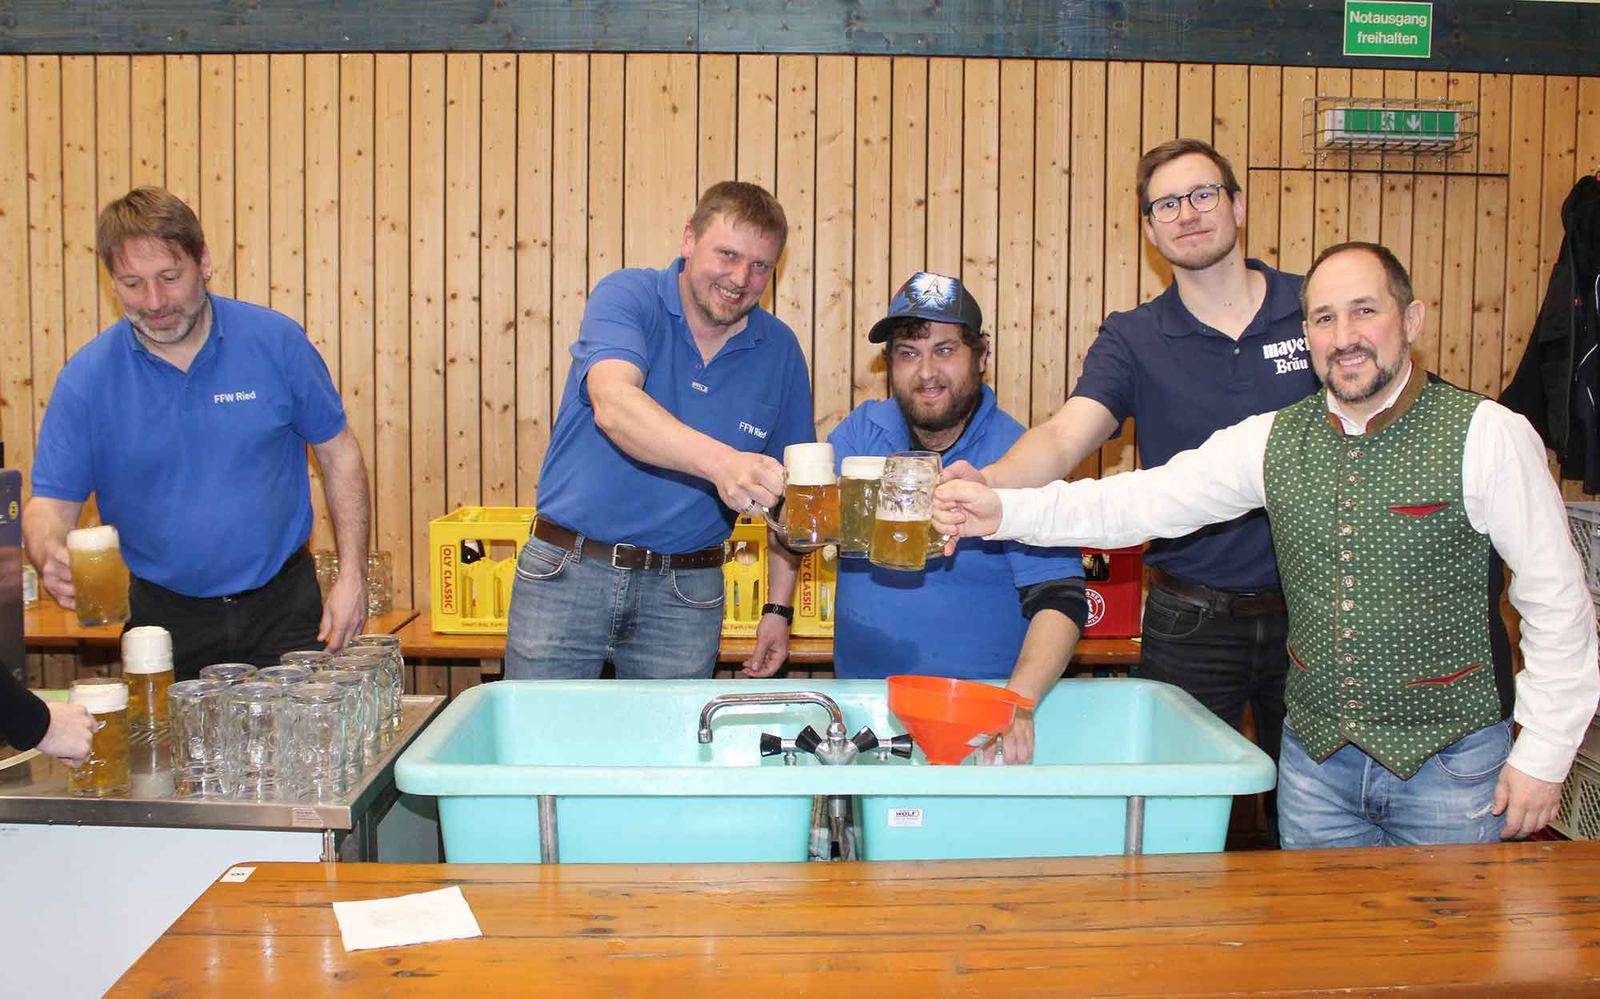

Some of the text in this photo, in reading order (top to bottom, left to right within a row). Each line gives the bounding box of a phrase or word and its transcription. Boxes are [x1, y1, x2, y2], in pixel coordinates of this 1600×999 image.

[1349, 11, 1427, 27] Notausgang
[1357, 32, 1418, 45] freihalten
[1273, 357, 1308, 375] Bräu
[214, 390, 256, 404] FFW Ried
[443, 548, 453, 609] OLY CLASSIC
[803, 572, 812, 611] CLASSIC
